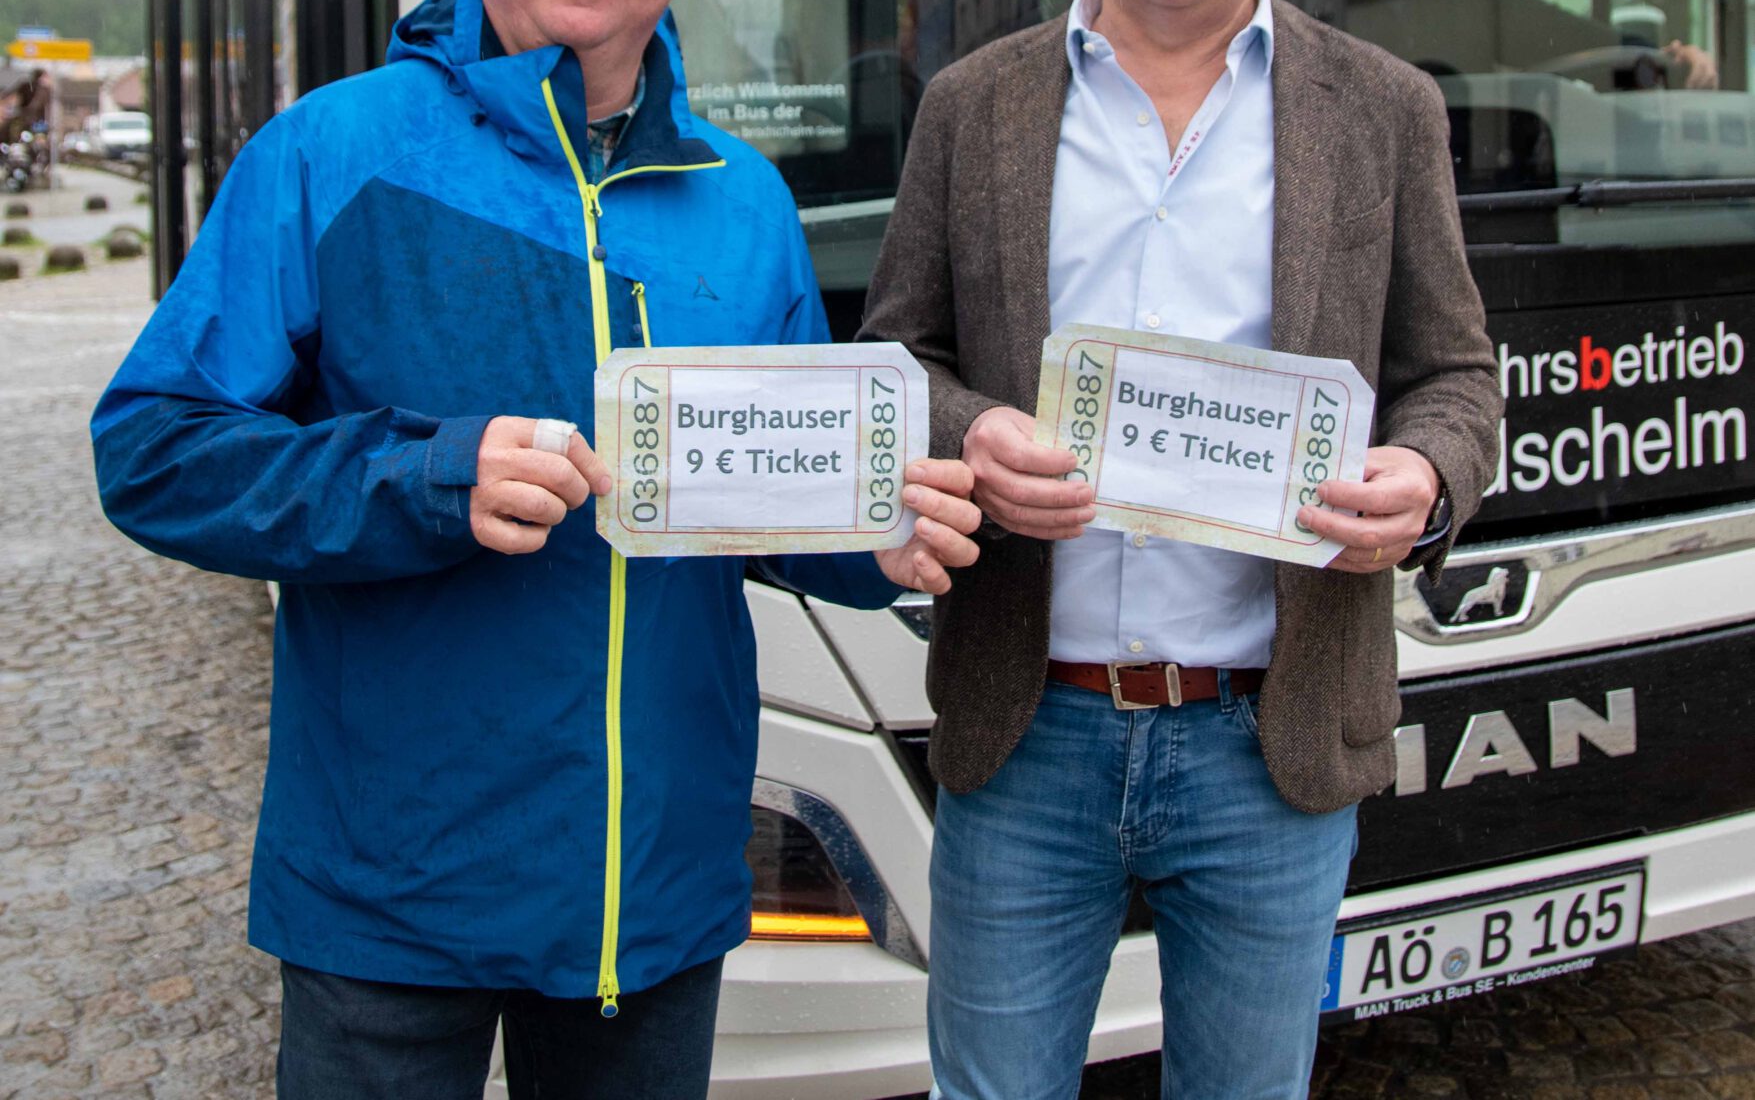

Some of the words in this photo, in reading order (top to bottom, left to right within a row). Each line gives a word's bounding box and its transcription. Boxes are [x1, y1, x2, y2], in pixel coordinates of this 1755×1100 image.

[707, 104, 730, 119] im
[733, 103, 769, 120] Bus
[773, 101, 803, 119] der
[738, 81, 846, 99] Willkommen
[1499, 321, 1744, 399] hrsbetrieb
[677, 403, 852, 435] Burghauser
[1118, 381, 1291, 430] Burghauser
[632, 376, 659, 523] 036887
[686, 448, 704, 474] 9
[715, 449, 734, 474] €
[745, 449, 842, 474] Ticket
[868, 376, 896, 523] 036887
[1122, 423, 1139, 447] 9
[1150, 429, 1169, 454] €
[1179, 433, 1274, 473] Ticket
[1360, 925, 1435, 994] AÖ
[1480, 910, 1513, 968] B
[1529, 884, 1627, 958] 165
[1354, 1002, 1389, 1020] MAN
[1393, 991, 1430, 1012] Truck
[1432, 989, 1443, 1003] &
[1446, 985, 1472, 1001] Bus
[1474, 978, 1494, 995] SE
[1507, 956, 1596, 986] Kundencenter
